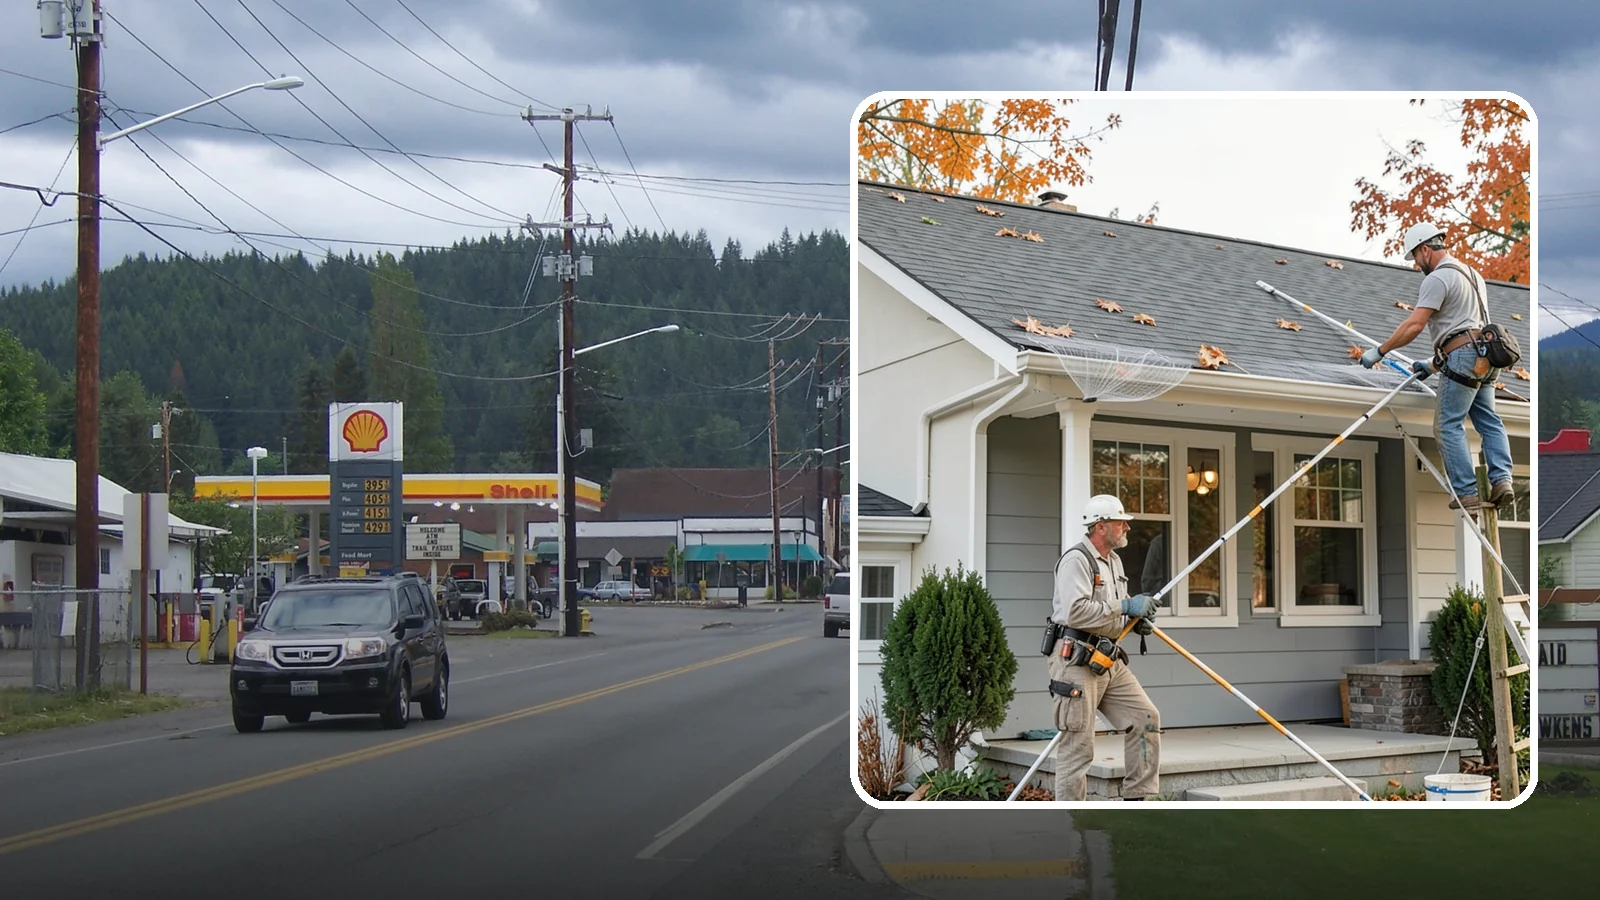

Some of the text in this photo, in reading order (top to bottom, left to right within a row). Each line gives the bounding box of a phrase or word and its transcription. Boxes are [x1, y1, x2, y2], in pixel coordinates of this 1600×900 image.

[365, 480, 384, 490] 395
[490, 484, 547, 499] Shell
[365, 494, 384, 504] 405
[365, 508, 384, 518] 415
[365, 522, 384, 532] 429
